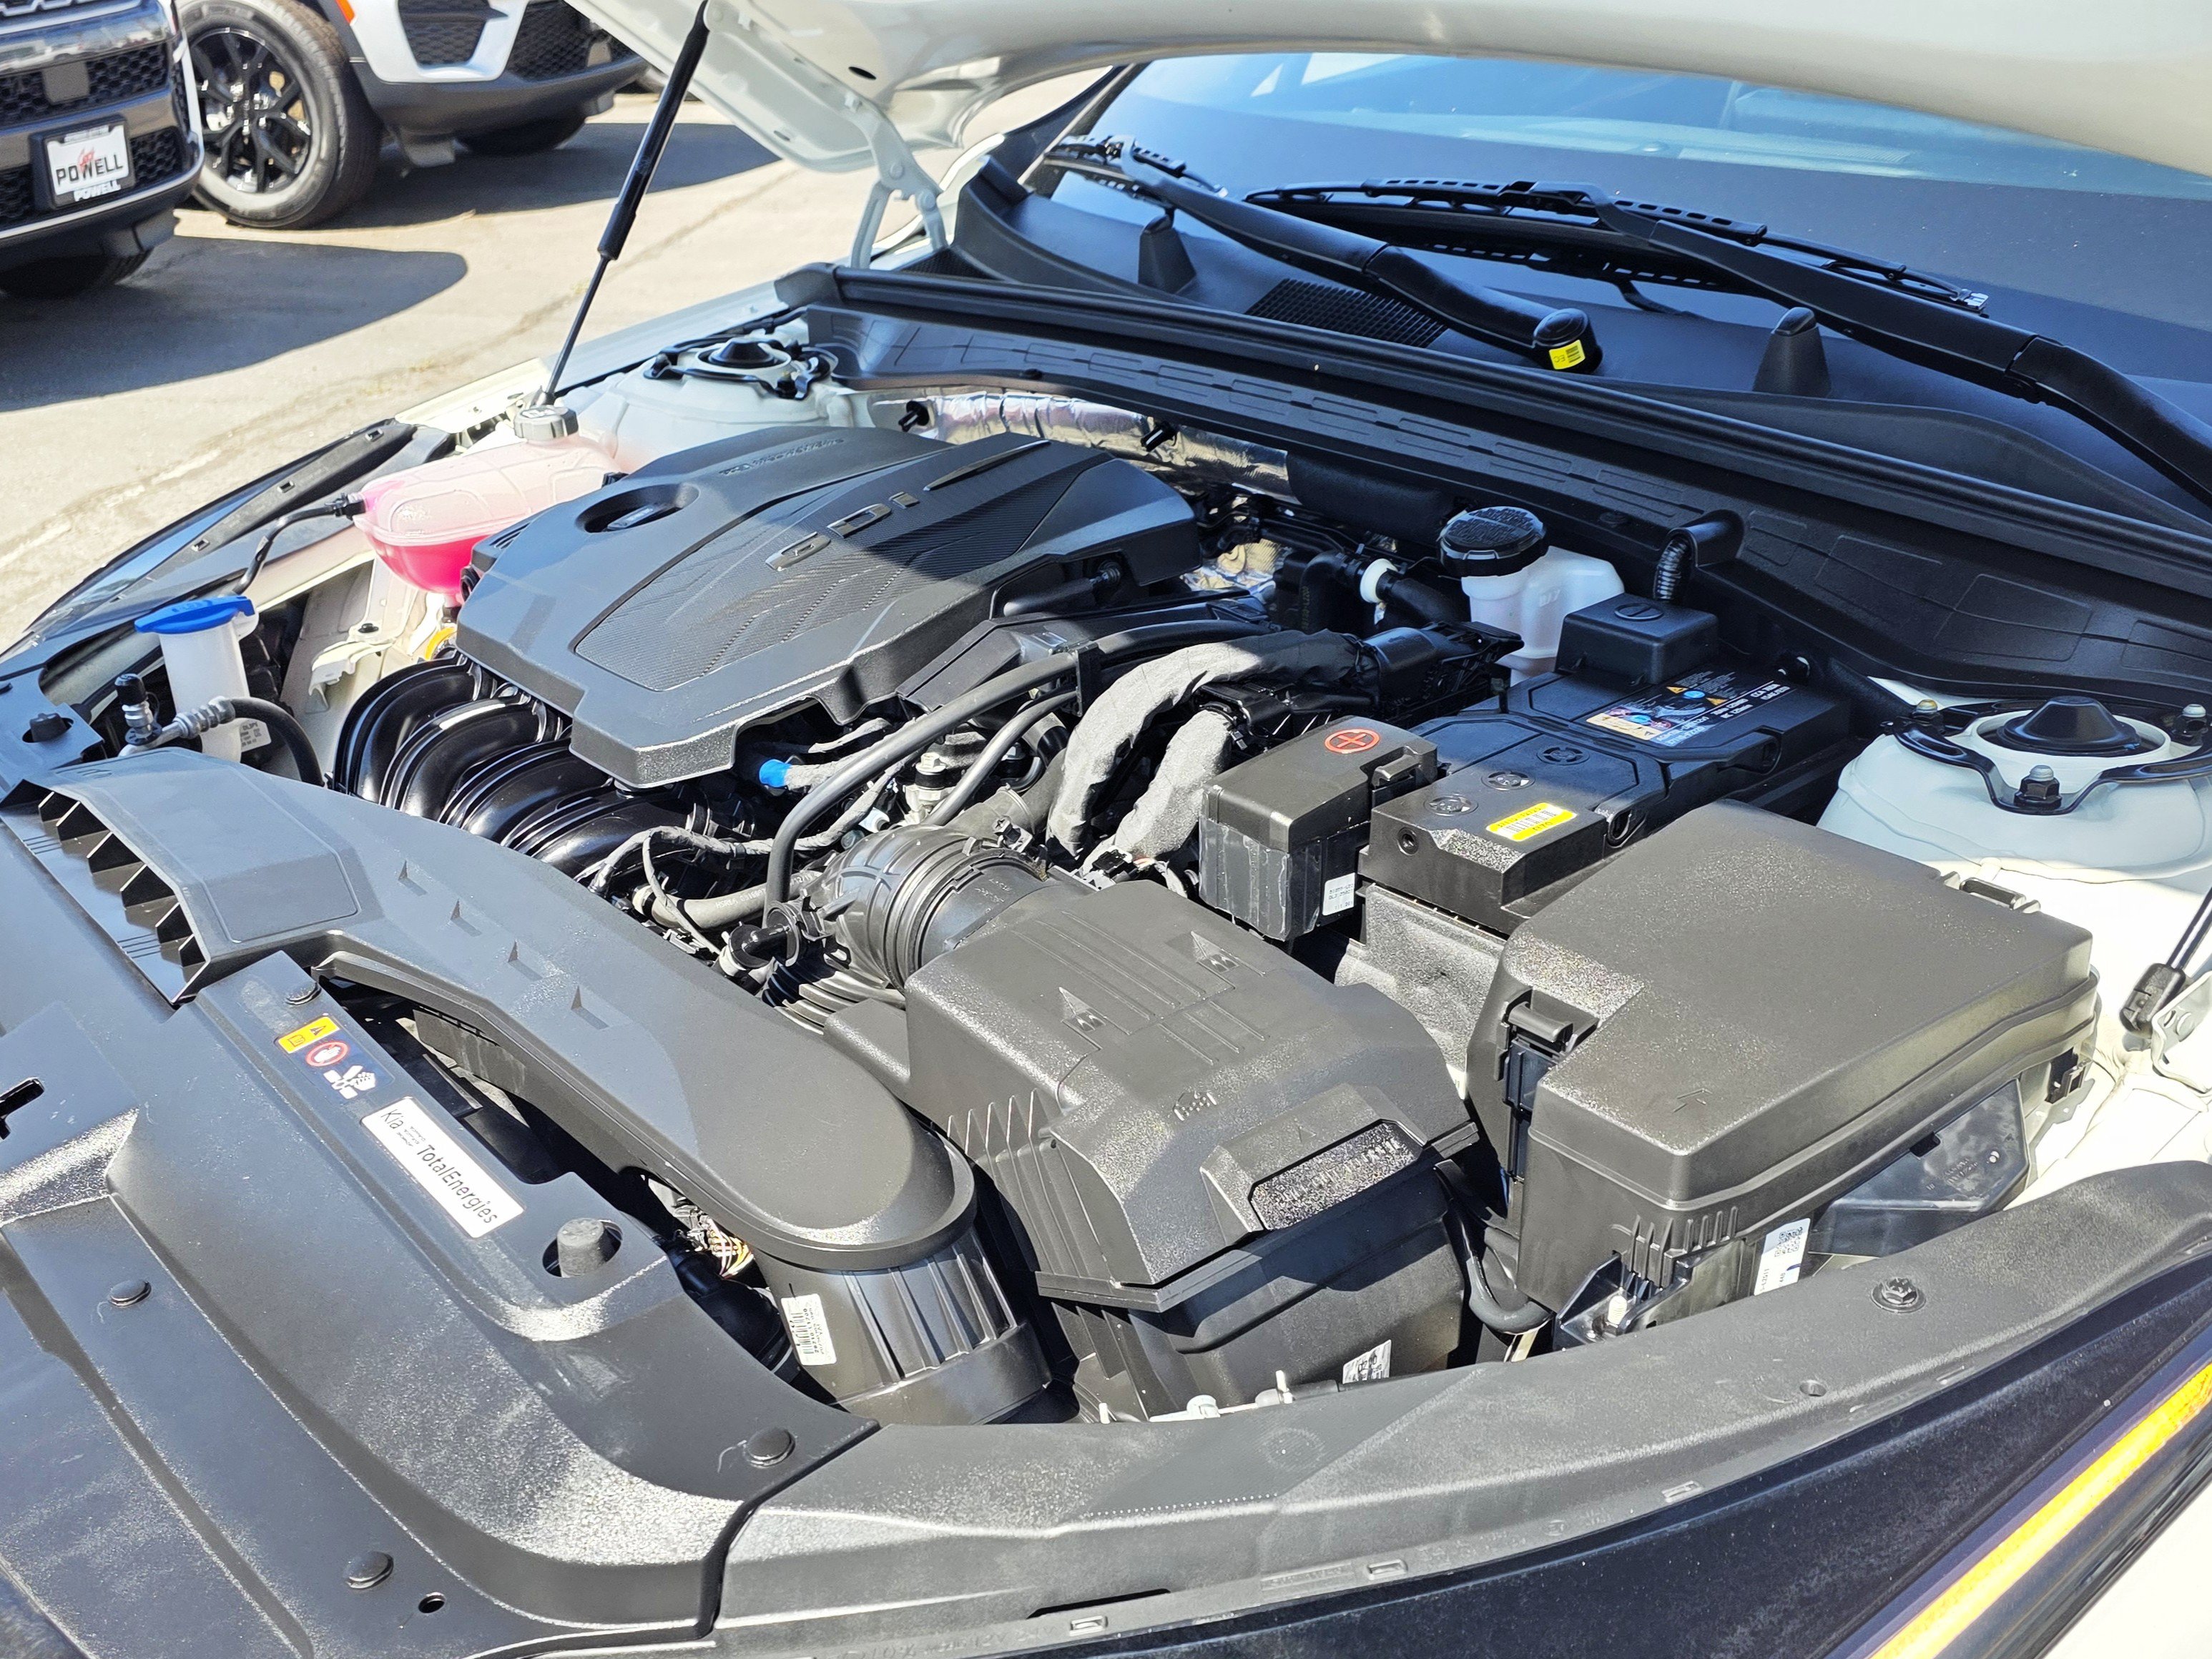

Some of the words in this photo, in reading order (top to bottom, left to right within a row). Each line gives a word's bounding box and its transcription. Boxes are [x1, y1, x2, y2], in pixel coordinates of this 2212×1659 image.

[56, 154, 124, 187] POWELL
[380, 1109, 404, 1129] Kia
[417, 1144, 498, 1224] TotalEnergies
